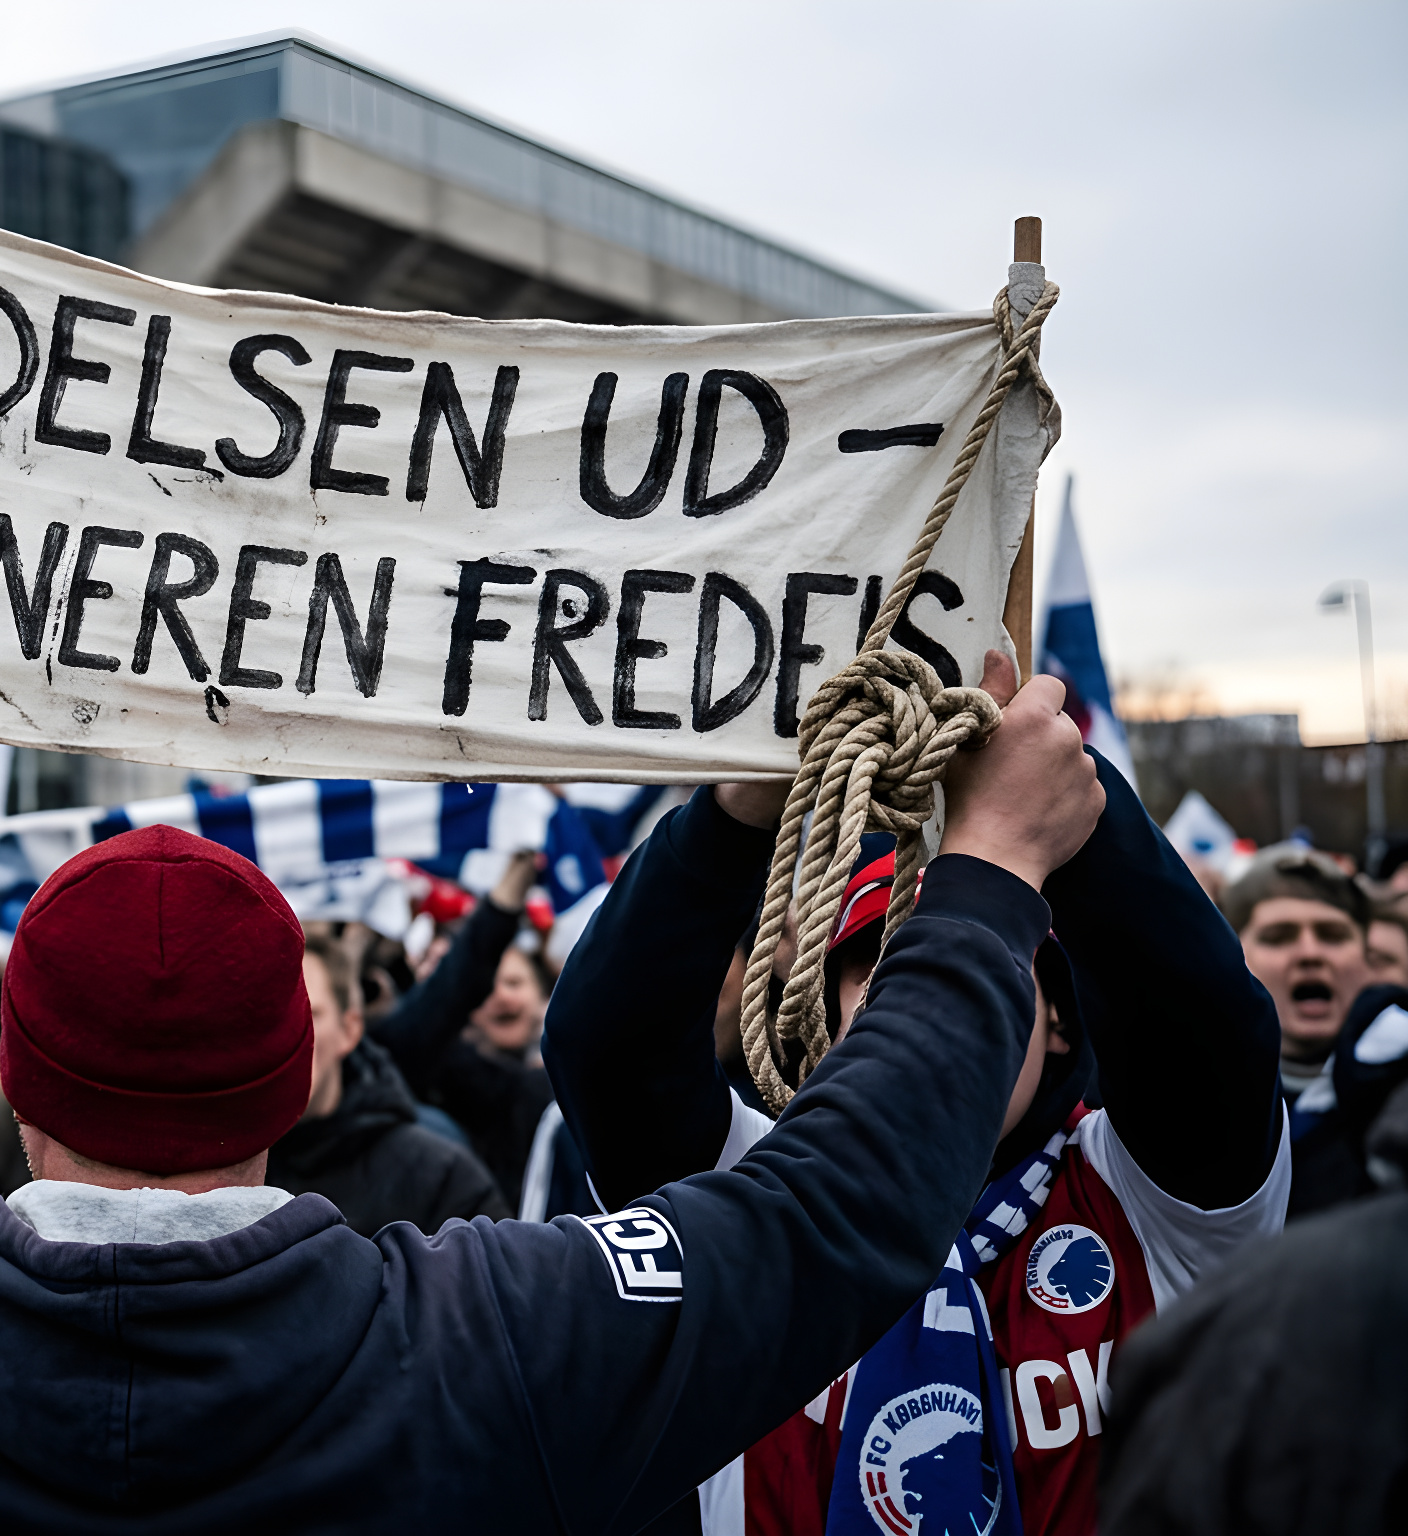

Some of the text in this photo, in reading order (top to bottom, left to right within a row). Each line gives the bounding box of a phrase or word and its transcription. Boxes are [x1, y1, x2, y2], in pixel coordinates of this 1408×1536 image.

[579, 367, 791, 520] UD
[865, 1435, 893, 1467] FC
[999, 1339, 1115, 1452] CK
